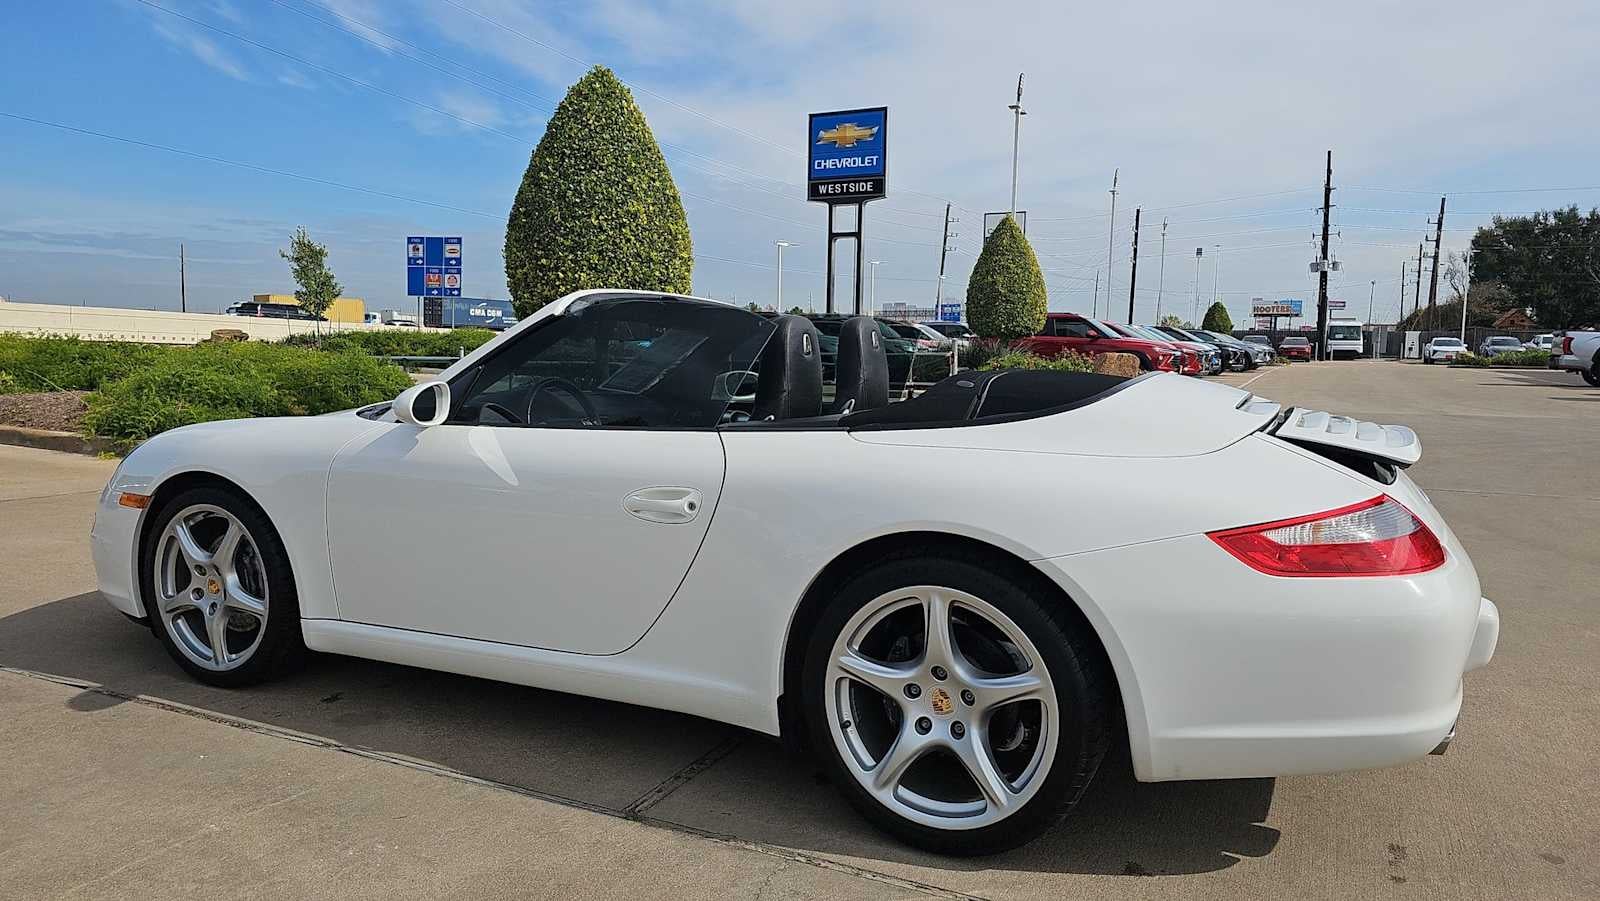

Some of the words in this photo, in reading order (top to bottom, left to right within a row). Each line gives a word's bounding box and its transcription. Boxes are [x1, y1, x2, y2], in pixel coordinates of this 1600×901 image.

[814, 156, 879, 169] CHEVROLET
[819, 182, 873, 194] WESTSIDE
[470, 308, 486, 316] CMA
[1254, 305, 1290, 313] HOOTERS
